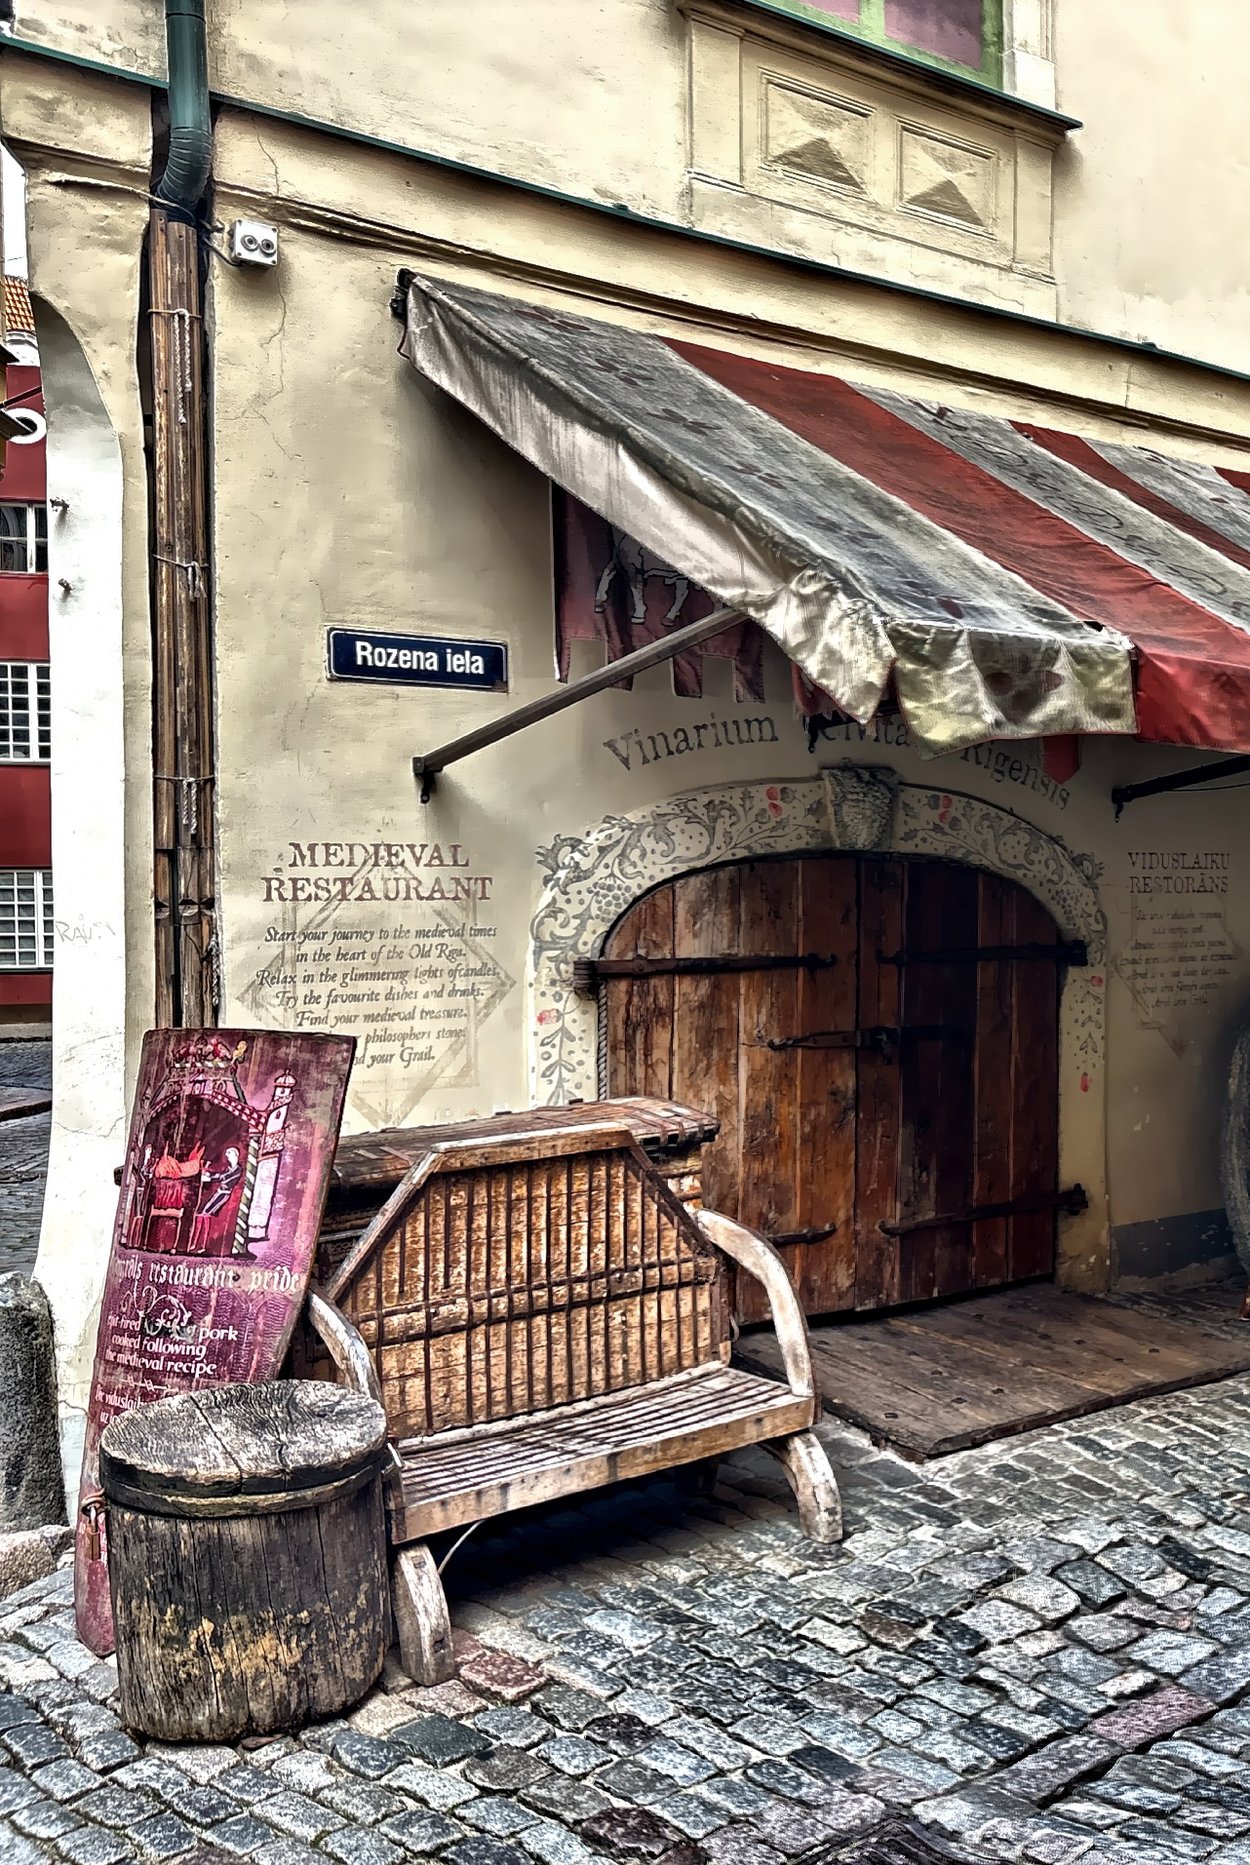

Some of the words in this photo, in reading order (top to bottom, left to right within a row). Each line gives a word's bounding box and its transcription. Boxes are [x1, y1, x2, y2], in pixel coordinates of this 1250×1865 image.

[355, 641, 439, 671] Rozena
[446, 649, 485, 674] iela
[602, 712, 779, 772] Vinarium
[288, 842, 469, 867] MEDIEVAL
[1128, 852, 1230, 870] VIDUSLAIKU
[261, 877, 493, 902] RESTAURANT
[1129, 873, 1229, 893] RESTORĀNS
[265, 926, 297, 942] Start
[298, 930, 327, 944] your
[328, 928, 374, 945] journey
[379, 927, 389, 940] to
[393, 925, 410, 939] the
[415, 923, 464, 939] medieval
[469, 924, 497, 938] times
[296, 948, 308, 963] in
[313, 946, 331, 962] the
[336, 946, 367, 962] heart
[371, 944, 386, 966] of
[387, 944, 404, 960] the
[409, 943, 432, 960] Old
[435, 943, 466, 963] Riga.
[256, 970, 297, 988] Relax
[303, 969, 314, 984] in
[318, 967, 337, 983] the
[340, 968, 409, 987] glimmering
[415, 964, 443, 985] lights
[276, 991, 297, 1008] Try
[303, 989, 321, 1004] the
[325, 990, 380, 1008] favourite
[385, 987, 417, 1004] dishes
[423, 985, 443, 1000] and
[296, 1010, 328, 1027] Find
[331, 1014, 358, 1028] your
[363, 1006, 415, 1024] medieval
[364, 1026, 431, 1049] philosophers
[367, 1052, 395, 1067] your
[400, 1046, 435, 1068] Grail.
[149, 1262, 235, 1287] restaurant
[248, 1265, 300, 1295] pride
[199, 1325, 239, 1343] pork
[112, 1332, 139, 1349] cooked
[142, 1337, 206, 1361] following
[117, 1349, 163, 1371] medieval
[166, 1360, 217, 1379] recipe
